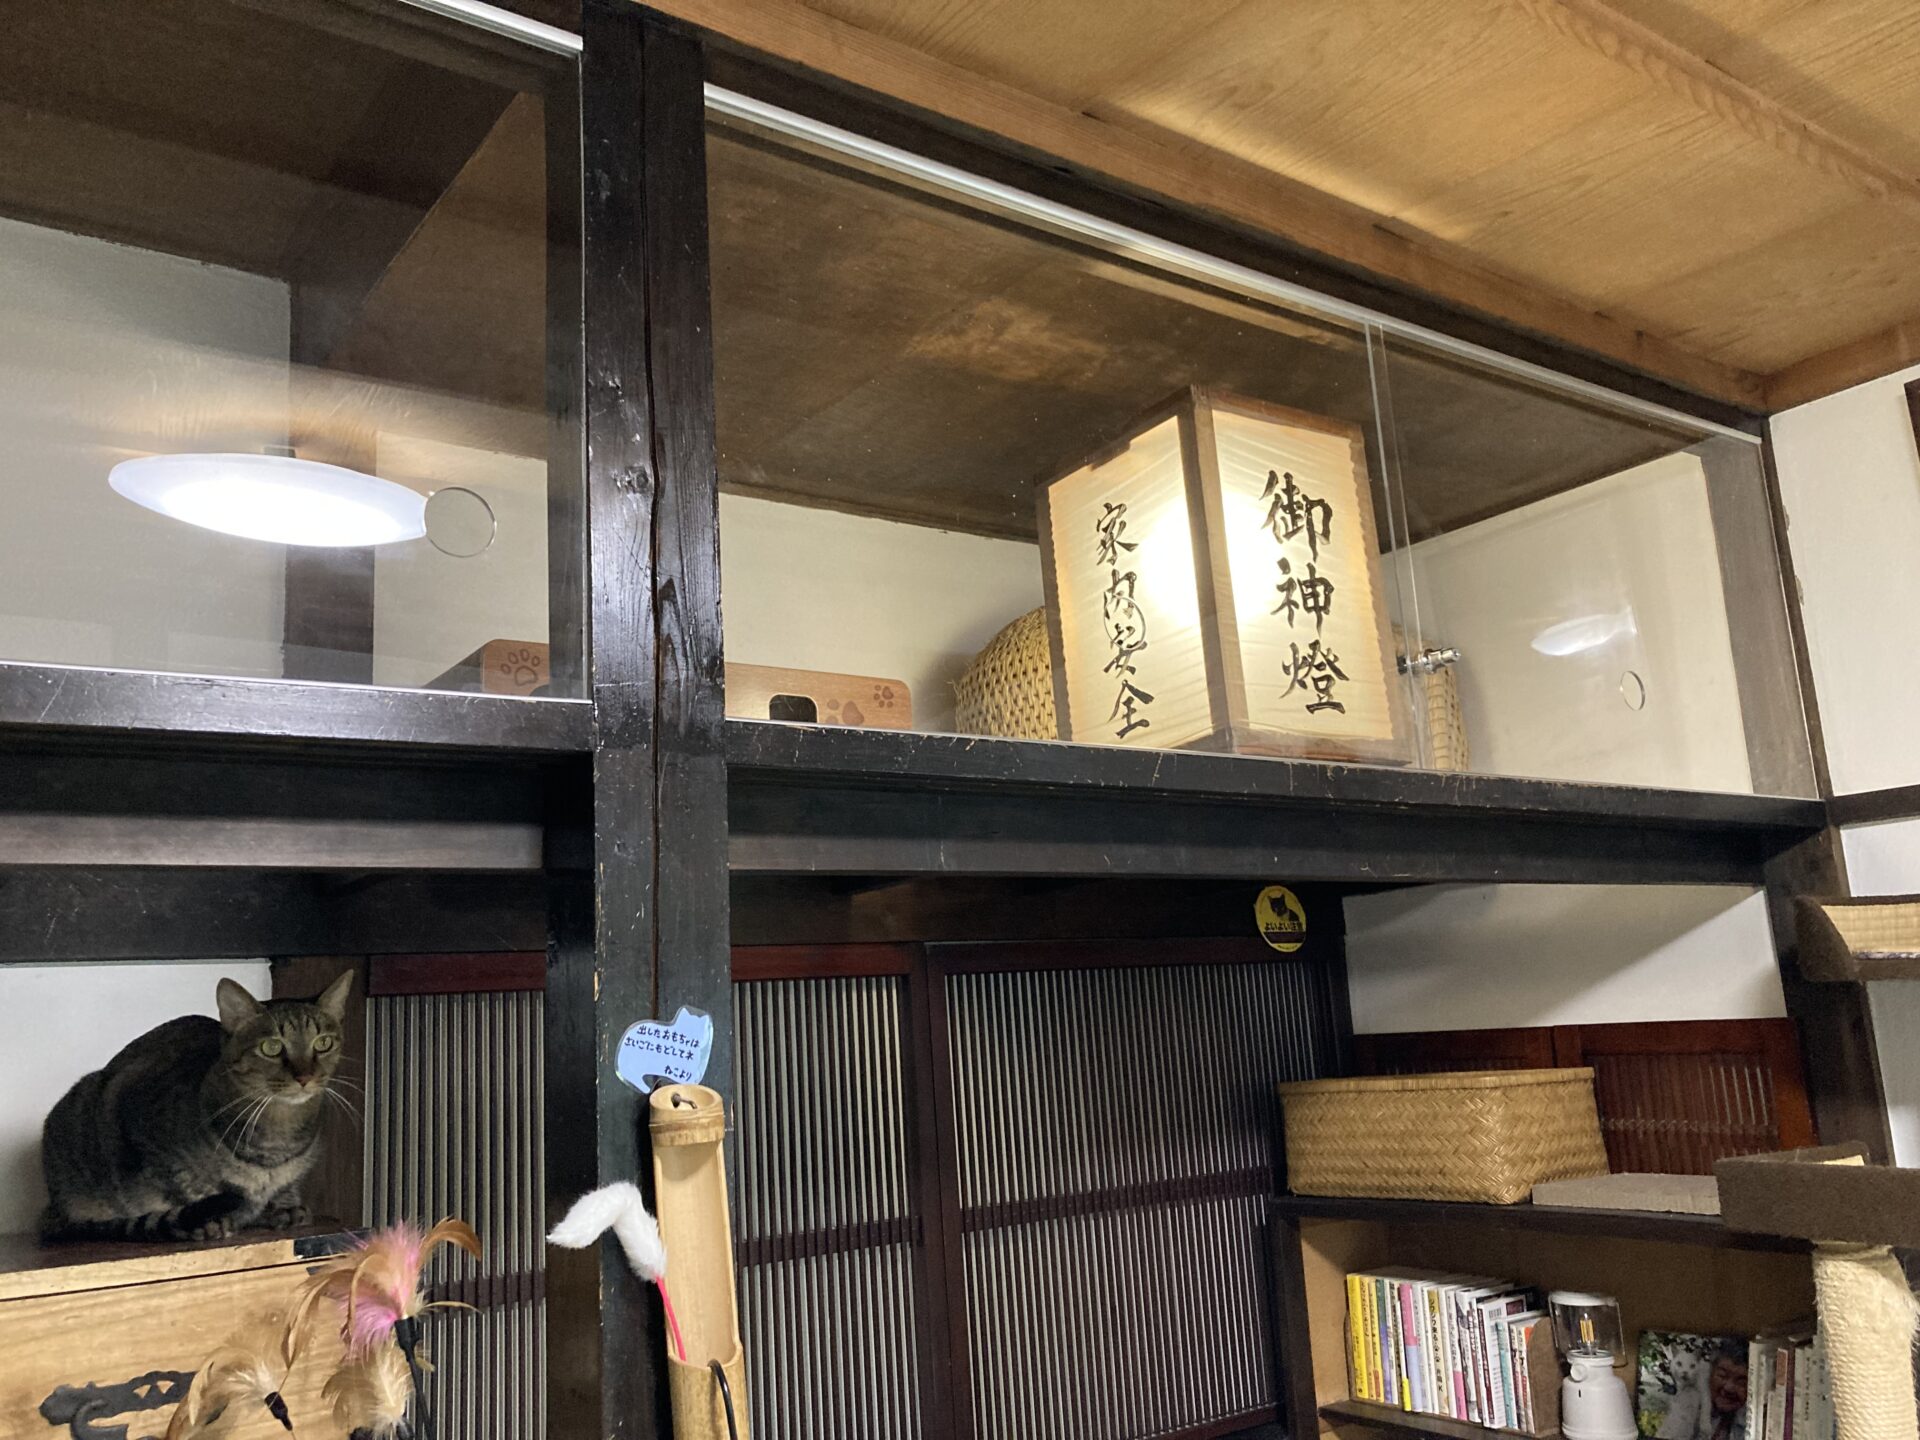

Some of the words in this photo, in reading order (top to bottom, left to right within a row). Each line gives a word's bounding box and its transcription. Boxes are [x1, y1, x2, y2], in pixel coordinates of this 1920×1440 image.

[1096, 501, 1155, 739] 家内安全
[1258, 469, 1351, 715] 御神燈
[636, 1024, 700, 1048] 出したおもちゃは
[664, 1065, 693, 1081] ねこより
